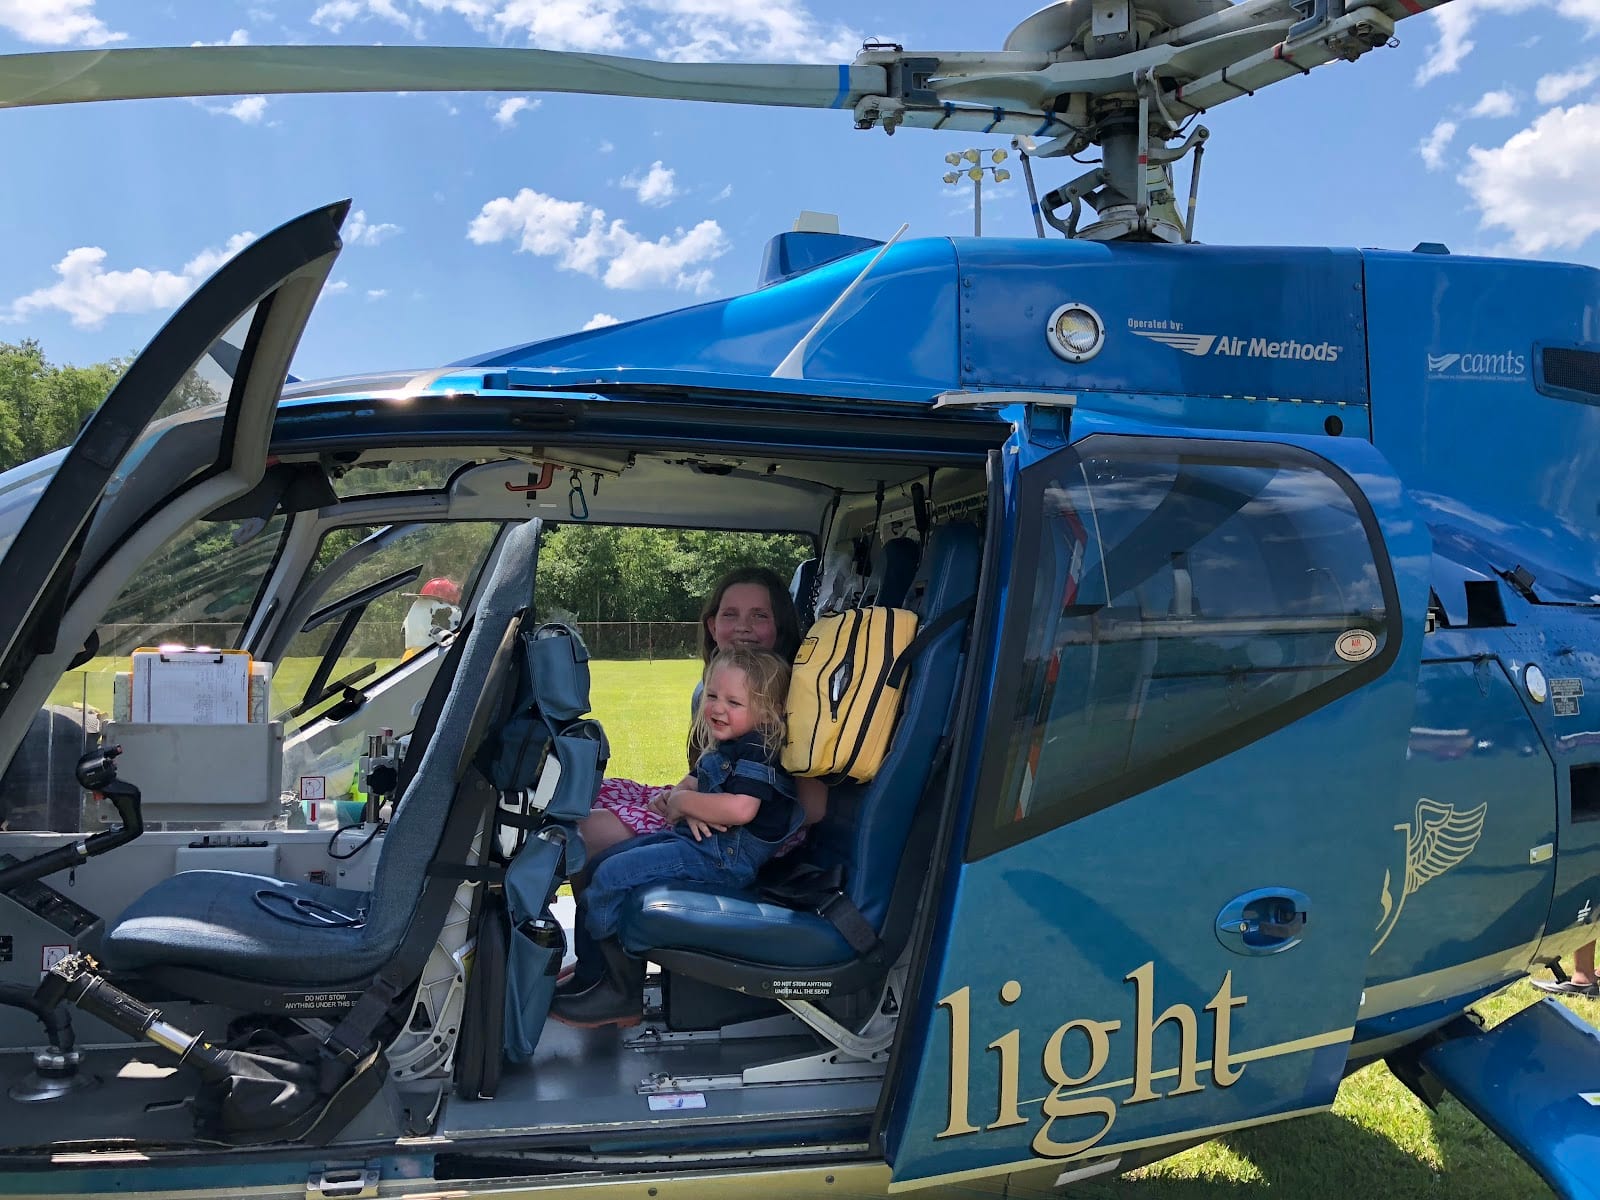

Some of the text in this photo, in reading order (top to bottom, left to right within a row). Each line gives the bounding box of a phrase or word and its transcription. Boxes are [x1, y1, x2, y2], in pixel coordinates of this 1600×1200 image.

[1127, 317, 1184, 332] Operated by:
[1214, 335, 1338, 362] Air Methods
[1460, 349, 1525, 375] camts
[285, 1001, 315, 1009] ANYTHING
[337, 1000, 351, 1008] THIS
[936, 960, 1248, 1157] light
